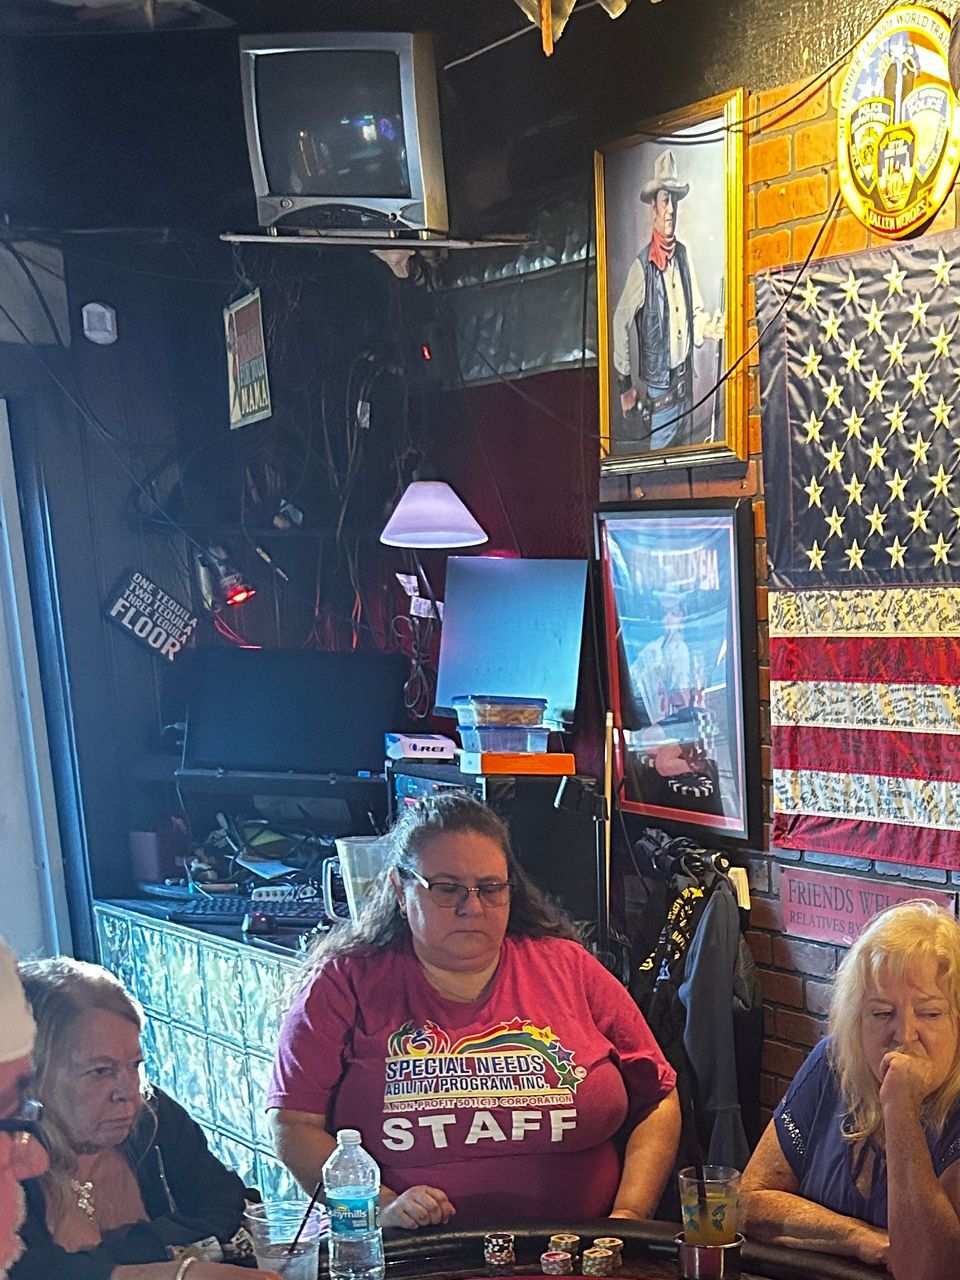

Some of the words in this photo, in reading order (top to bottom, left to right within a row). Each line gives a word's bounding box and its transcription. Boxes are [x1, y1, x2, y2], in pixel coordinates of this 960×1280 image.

[896, 13, 929, 28] WORLD
[869, 211, 895, 230] FALLEN
[896, 200, 926, 229] HEROES
[241, 379, 269, 415] MAMA
[123, 589, 153, 617] THREE
[152, 613, 188, 645] TEQUILA
[128, 580, 153, 603] TWO
[154, 600, 193, 636] TEQUILA
[132, 572, 156, 593] ONE
[156, 589, 198, 628] TEQUILA
[110, 597, 182, 661] FLOOR
[788, 878, 855, 914] FRIENDS
[790, 911, 846, 934] RELATIVES
[848, 922, 863, 935] BY
[386, 1057, 471, 1081] SPECIAL
[475, 1054, 545, 1076] NEEDS
[384, 1103, 393, 1112] A
[393, 1098, 456, 1112] NON-PROFIT
[457, 1097, 498, 1109] 501(C)3
[499, 1095, 573, 1106] CORPORATION
[385, 1079, 435, 1097] ABILITY
[439, 1076, 518, 1094] PROGRAM,
[521, 1075, 550, 1090] INC.
[382, 1109, 577, 1151] STAFF
